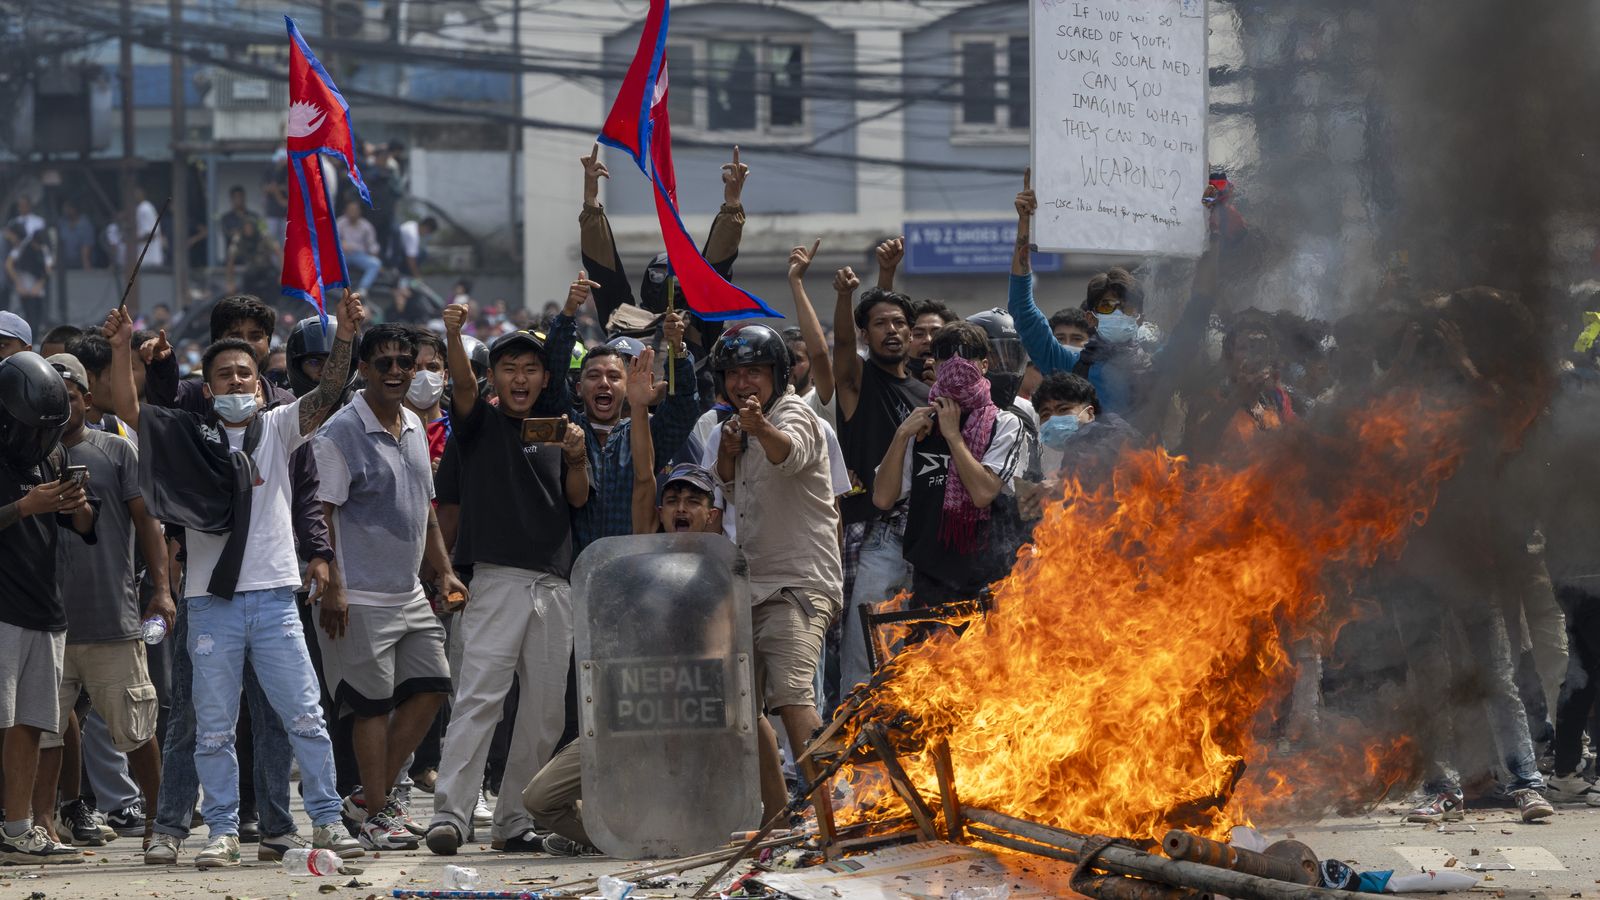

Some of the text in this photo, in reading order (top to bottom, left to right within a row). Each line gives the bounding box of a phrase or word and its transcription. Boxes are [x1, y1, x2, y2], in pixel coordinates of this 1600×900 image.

[1056, 25, 1103, 41] SCARED
[1110, 31, 1123, 44] OF
[1159, 15, 1172, 27] SO
[1058, 50, 1100, 67] USING
[1112, 52, 1156, 70] SOCIAL
[1083, 71, 1162, 101] CAN YOU
[1073, 94, 1189, 127] IMAGINE WHAT
[1063, 118, 1100, 148] THEY
[1106, 128, 1132, 143] CAN
[1141, 132, 1157, 147] DO
[910, 228, 922, 244] A
[621, 666, 709, 694] NEPAL
[618, 697, 718, 724] POLICE
